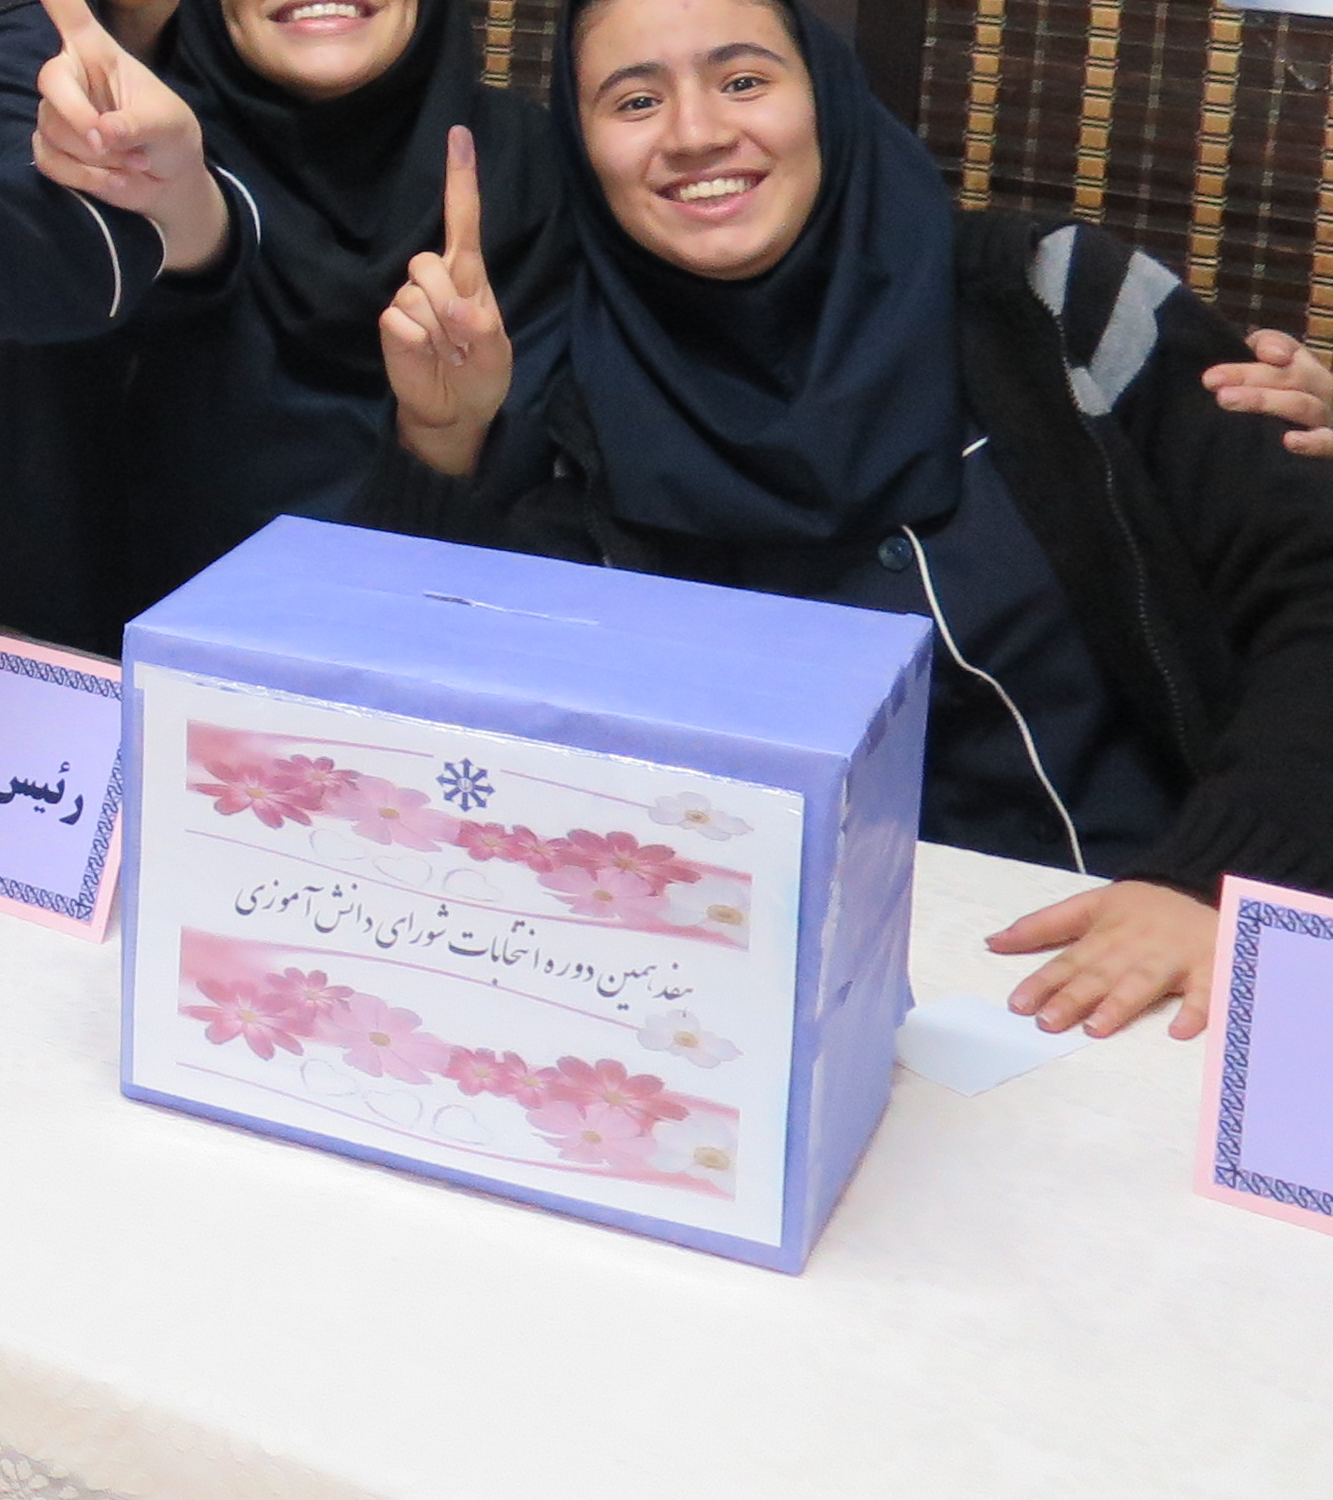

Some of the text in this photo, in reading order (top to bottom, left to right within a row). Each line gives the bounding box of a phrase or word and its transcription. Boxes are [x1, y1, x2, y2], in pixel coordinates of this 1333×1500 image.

[374, 903, 448, 950] شورای
[447, 918, 541, 988] انتخابات
[542, 956, 595, 984] دوره
